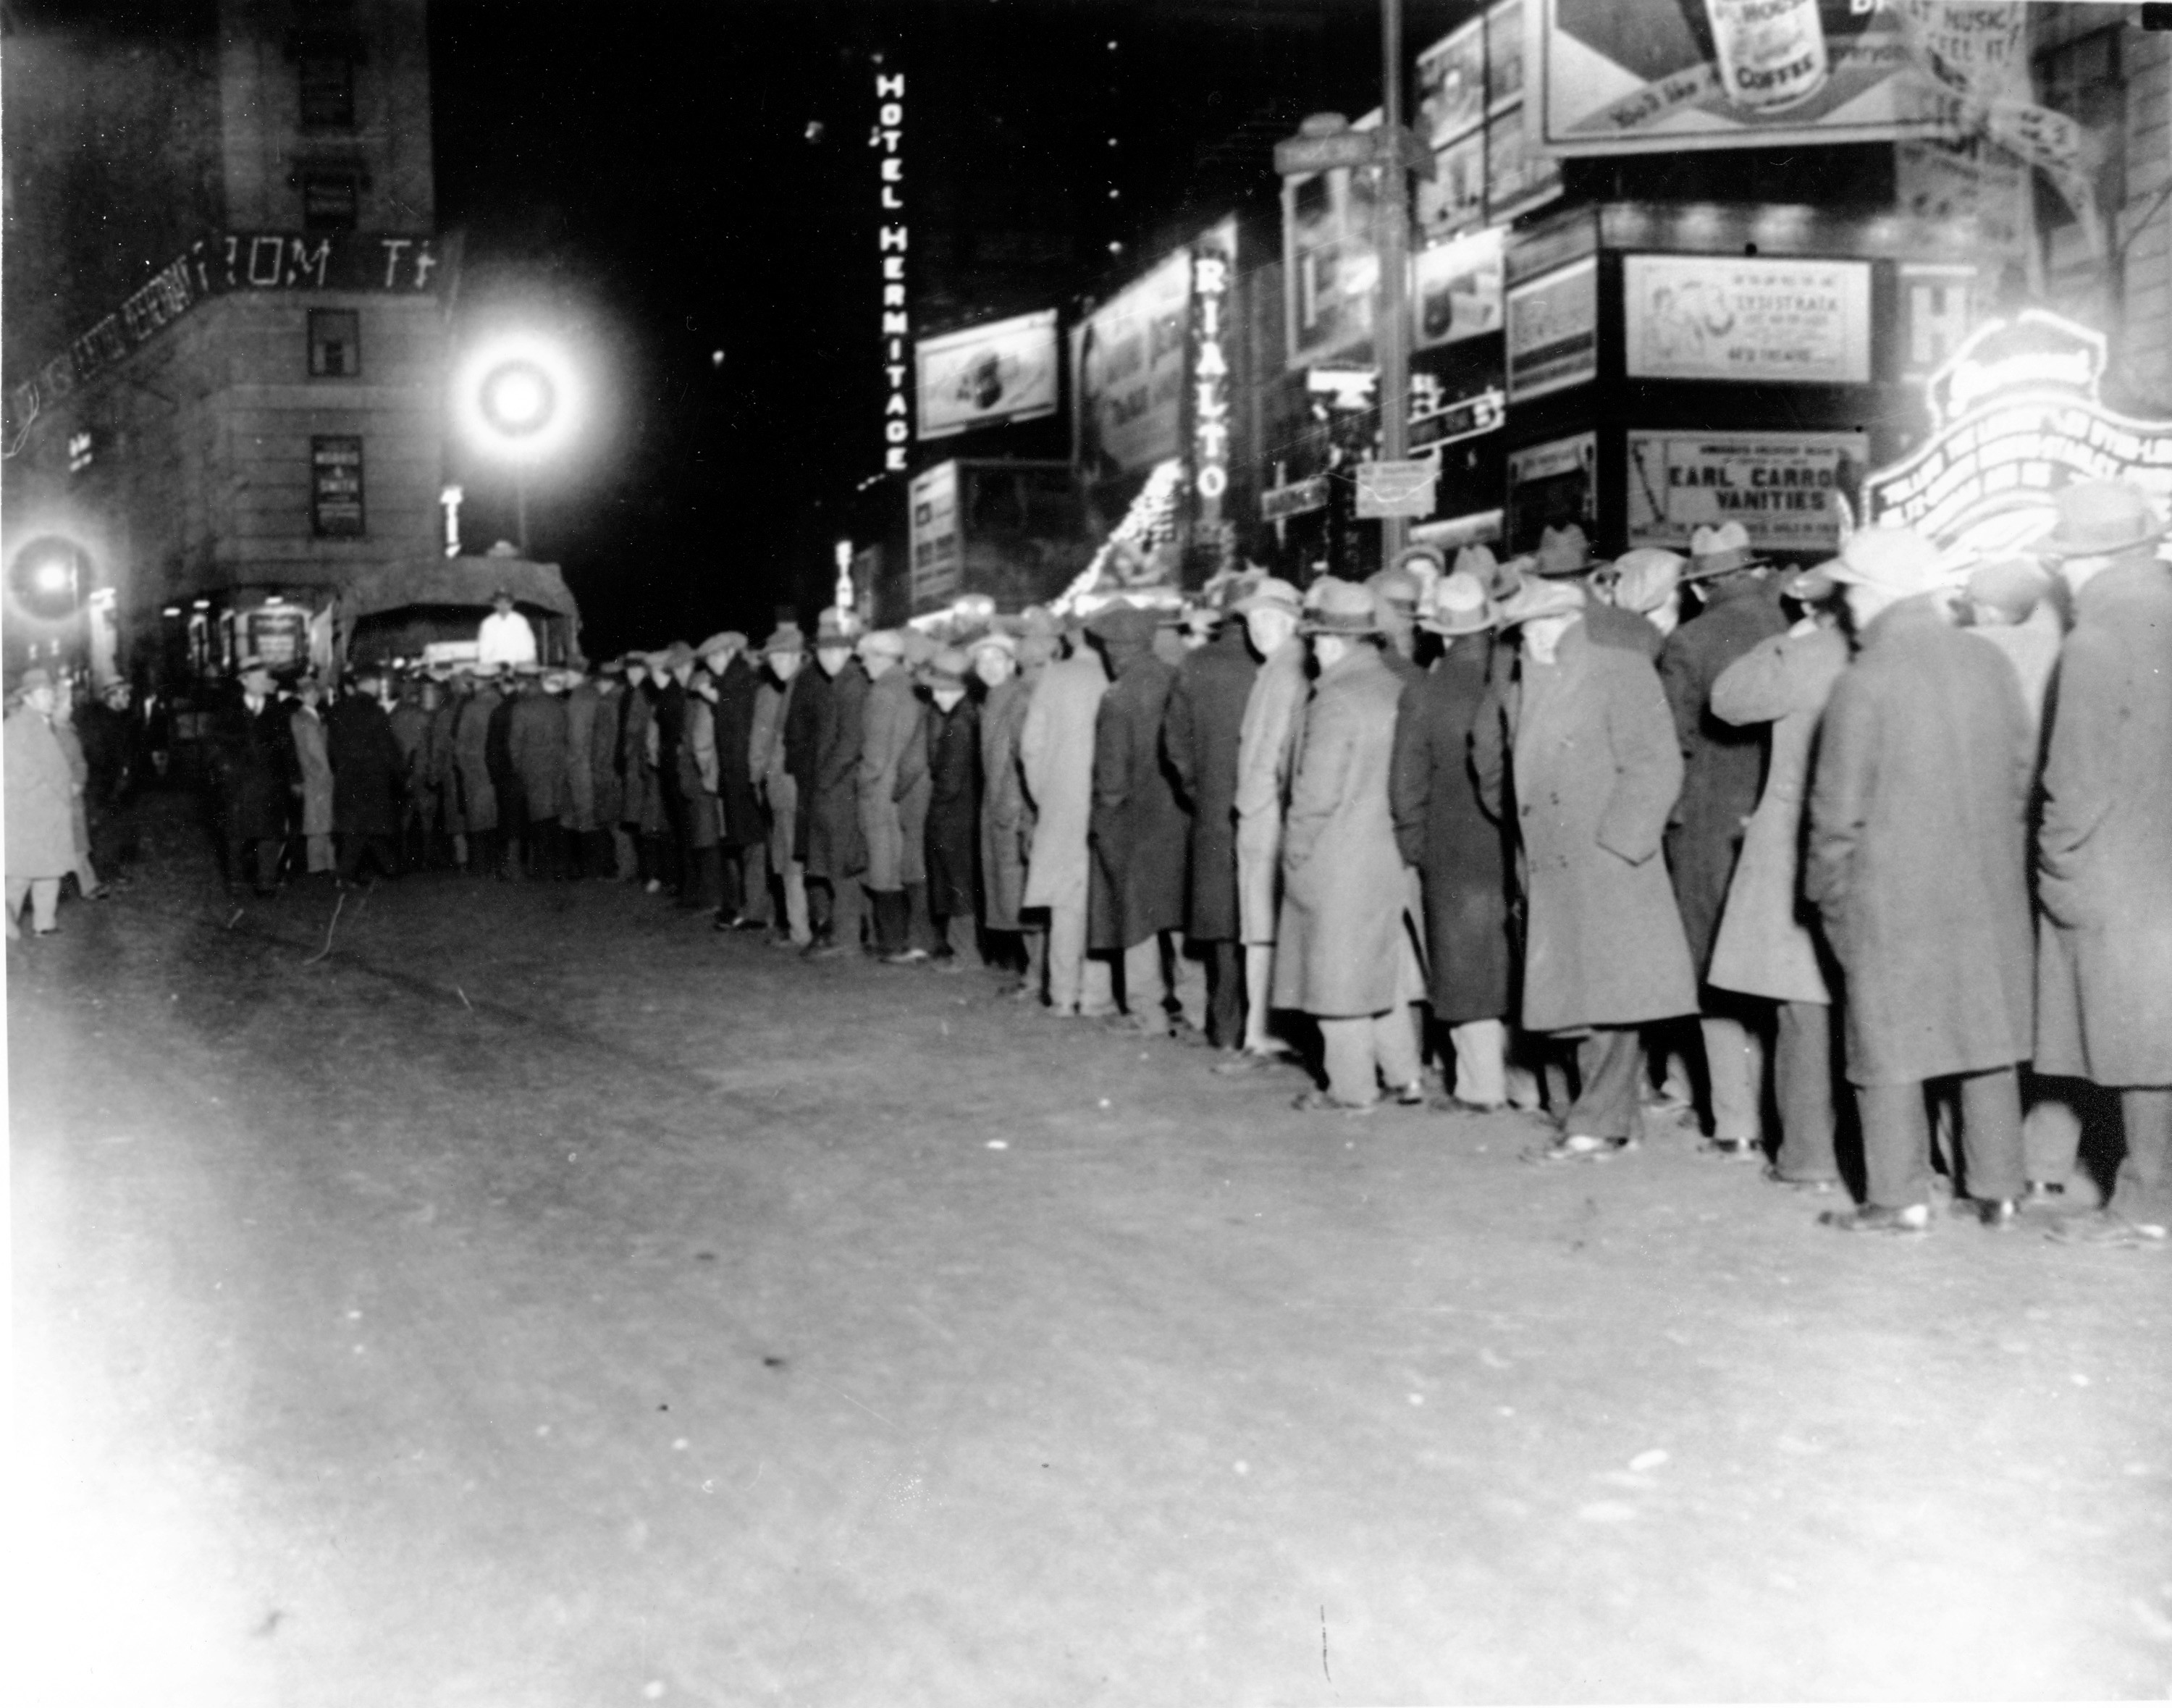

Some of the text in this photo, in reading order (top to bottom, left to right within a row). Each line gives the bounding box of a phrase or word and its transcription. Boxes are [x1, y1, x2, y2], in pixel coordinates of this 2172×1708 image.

[876, 73, 909, 471] HOTEL HERMITAGE
[1195, 258, 1229, 498] RIALTO
[1668, 466, 1837, 489] EARL CARRO
[1715, 489, 1826, 510] VANITIES
